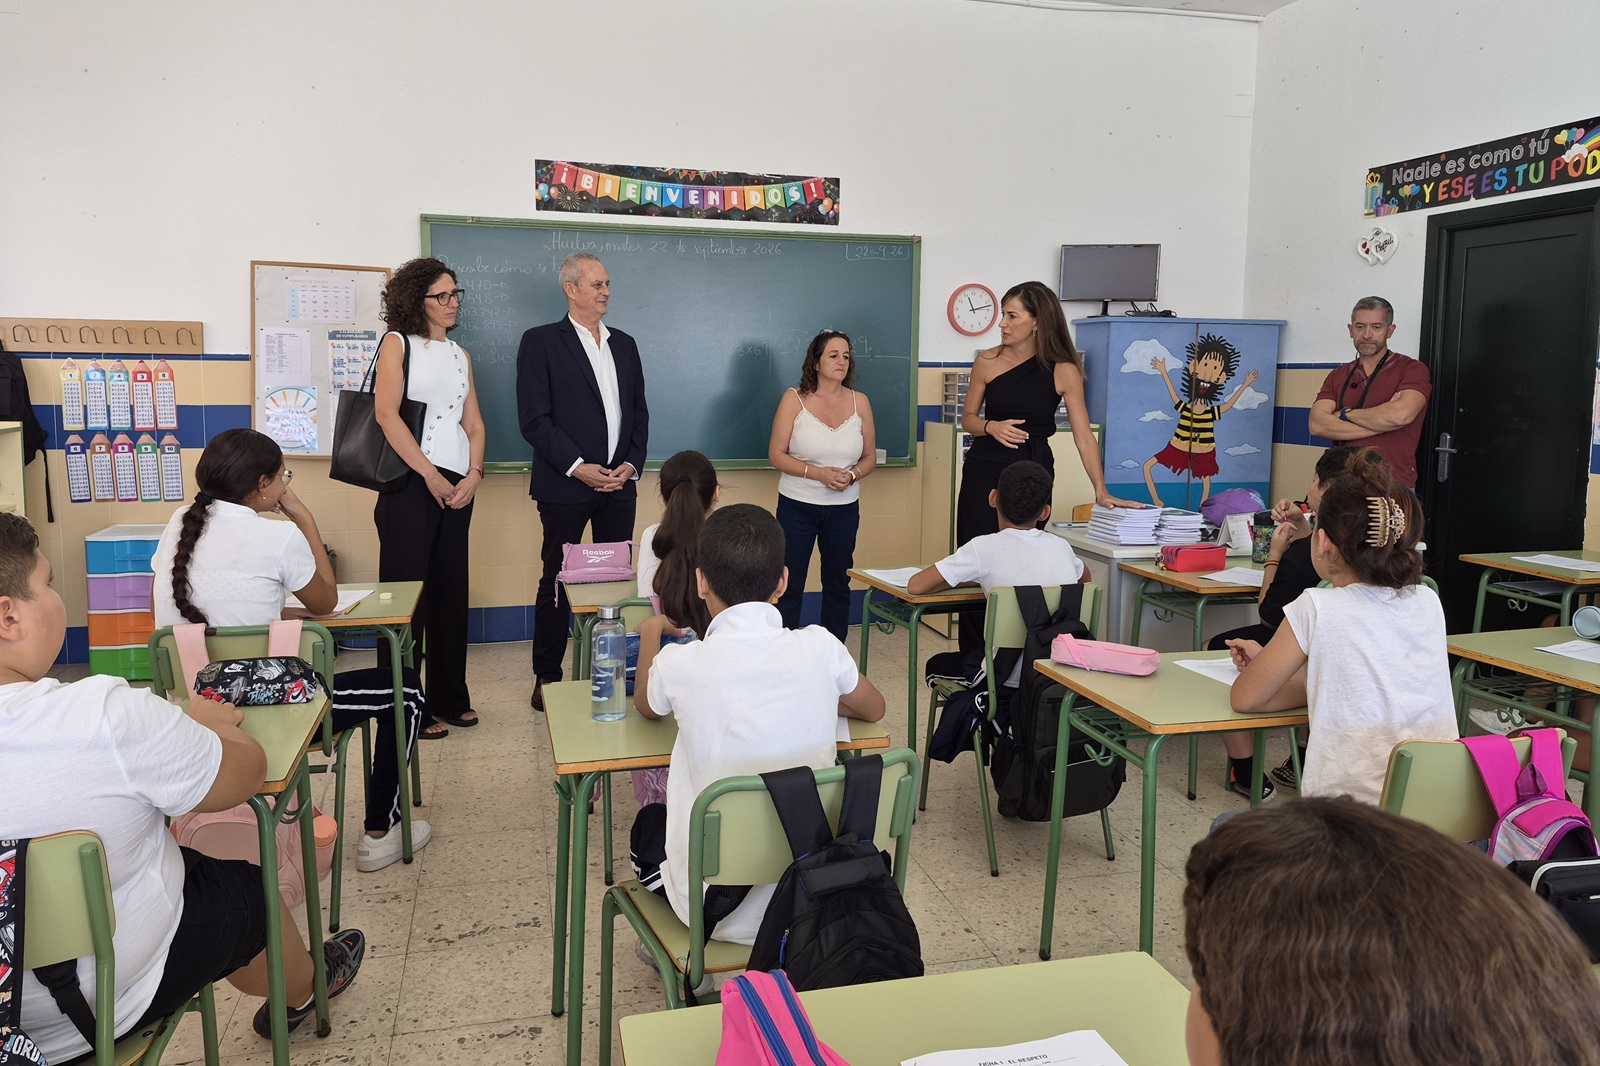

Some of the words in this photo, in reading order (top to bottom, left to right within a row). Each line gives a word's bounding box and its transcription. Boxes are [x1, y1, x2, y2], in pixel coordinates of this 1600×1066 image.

[1392, 160, 1441, 186] Nadie
[1445, 157, 1465, 174] es
[1469, 144, 1524, 169] como
[1529, 129, 1550, 157] tú
[561, 167, 817, 206] ¡BIENVENIDOS!
[1438, 173, 1477, 201] ESE
[1480, 167, 1507, 194] ES
[1515, 159, 1546, 187] TU
[753, 243, 782, 255] 2026
